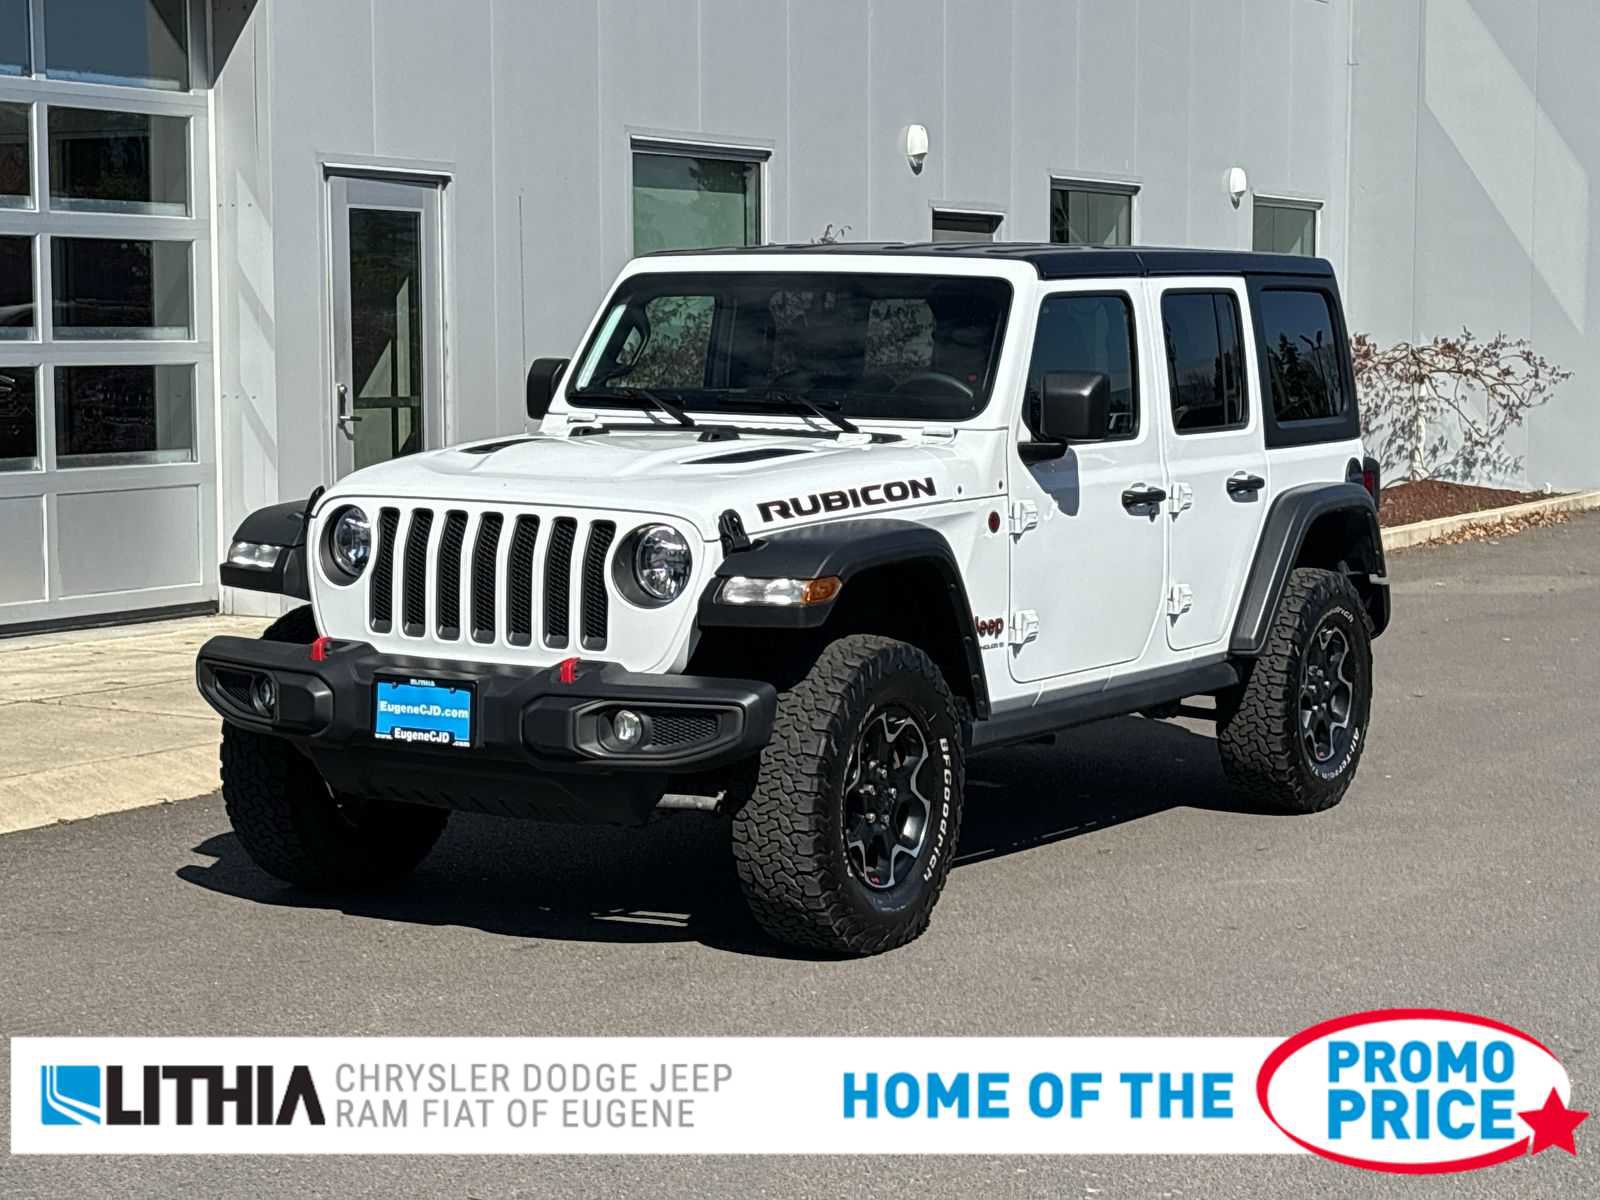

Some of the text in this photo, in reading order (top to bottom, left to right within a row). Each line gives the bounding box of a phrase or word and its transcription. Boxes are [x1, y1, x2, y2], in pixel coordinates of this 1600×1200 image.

[757, 477, 937, 522] RUBICON
[379, 700, 470, 719] EugeneCJD.com
[394, 727, 450, 744] EugeneCJD
